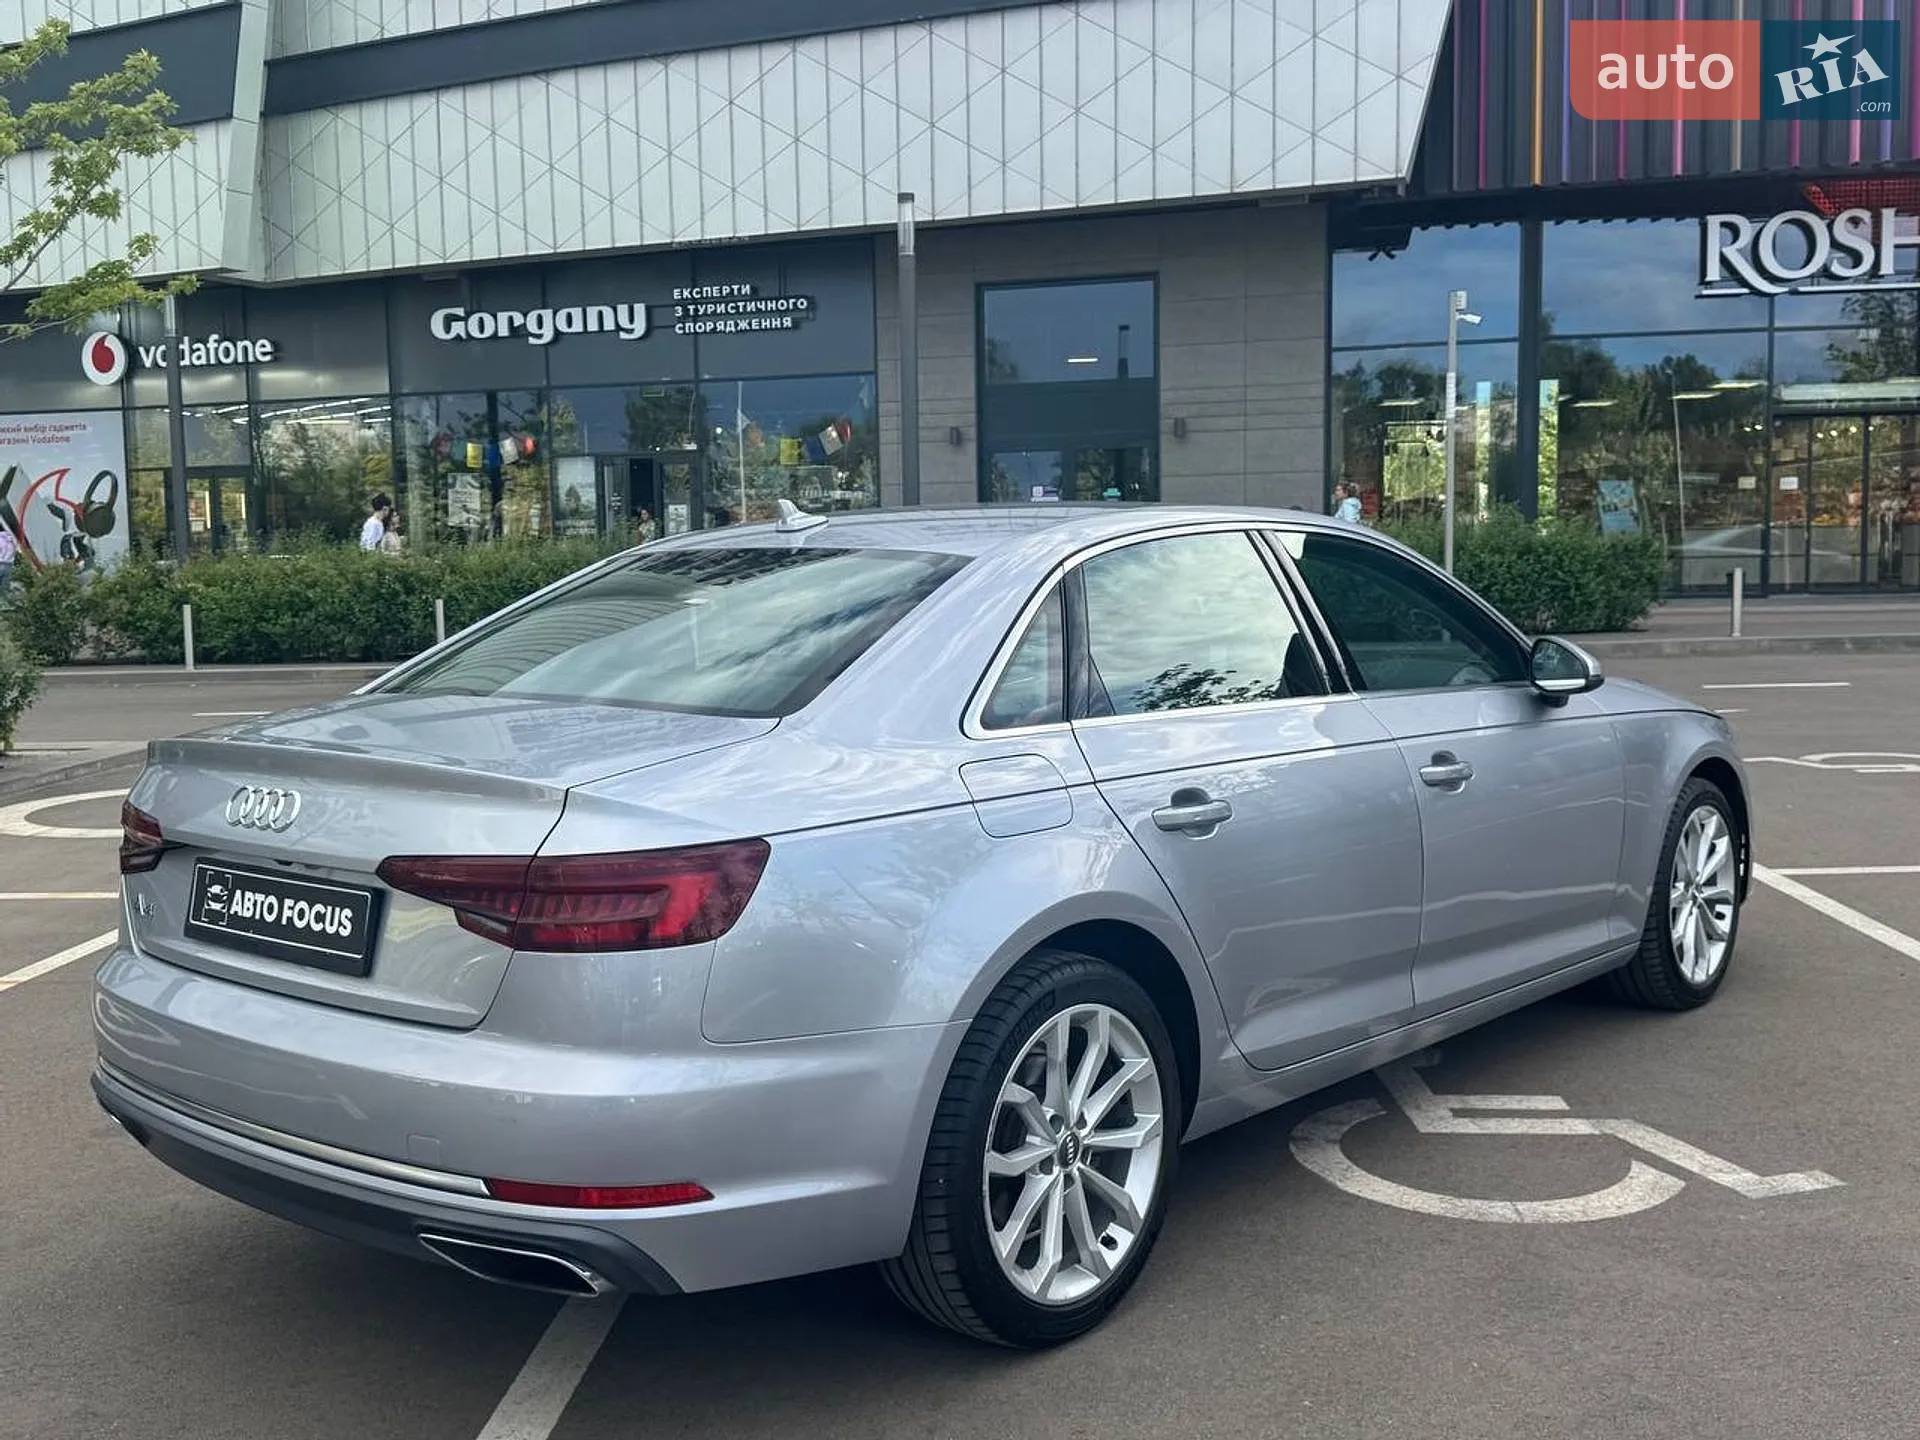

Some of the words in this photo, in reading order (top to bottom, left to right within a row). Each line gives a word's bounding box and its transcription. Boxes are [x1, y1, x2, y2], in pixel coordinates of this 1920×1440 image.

[673, 284, 751, 300] ЕКСПЕРТИ
[687, 298, 808, 316] ТУРИСТИЧНОГО
[430, 303, 646, 345] Gorgany
[674, 316, 793, 334] СПОРЯДЖЕННЯ
[31, 433, 71, 444] Vodafone
[281, 898, 353, 937] FOCUS
